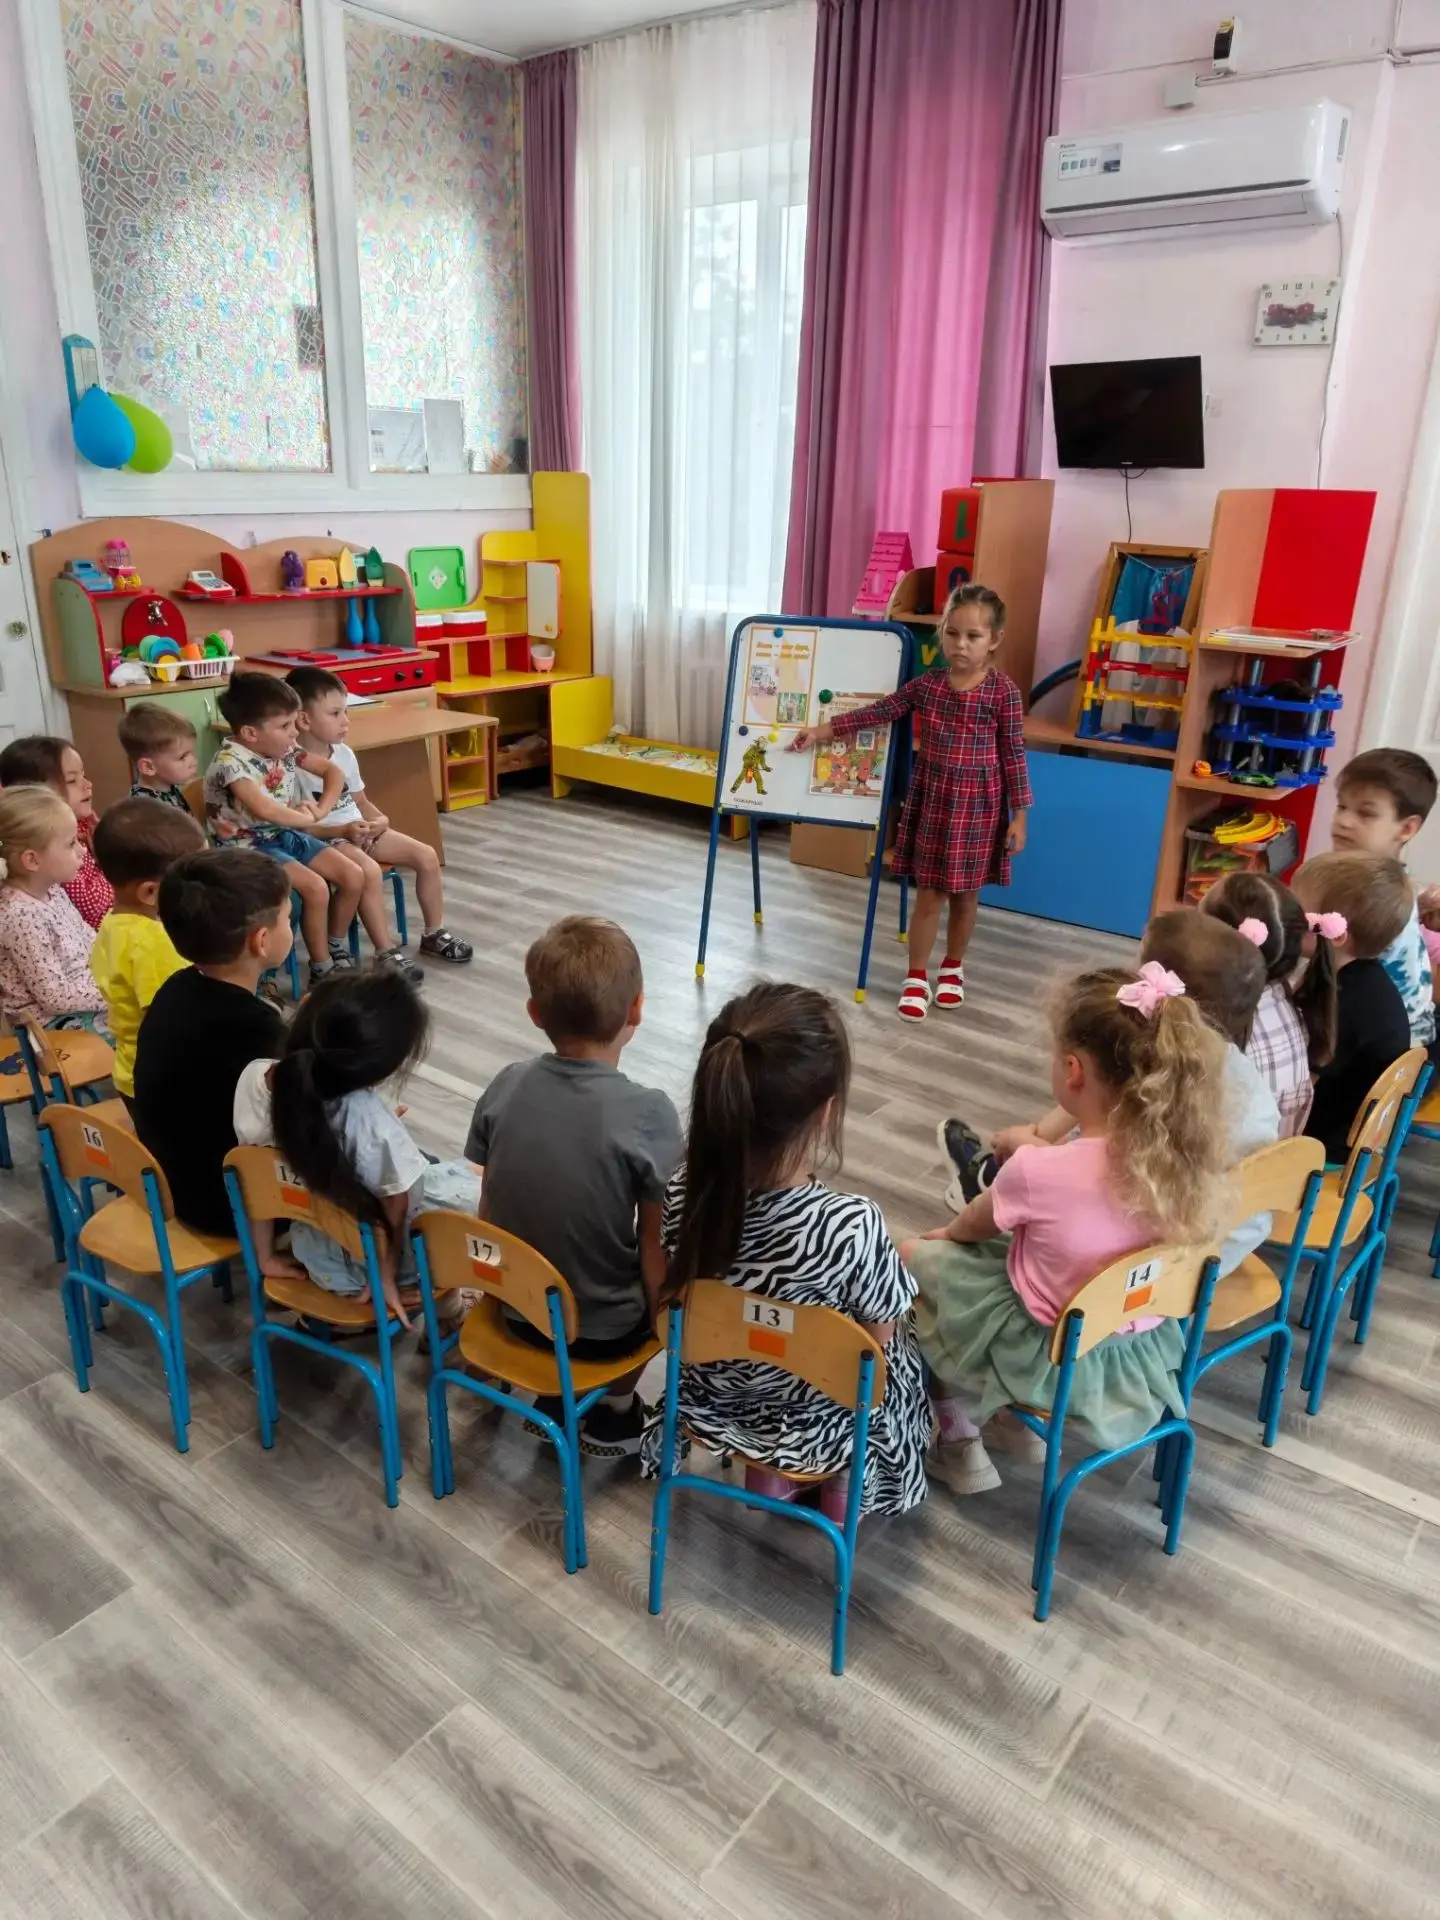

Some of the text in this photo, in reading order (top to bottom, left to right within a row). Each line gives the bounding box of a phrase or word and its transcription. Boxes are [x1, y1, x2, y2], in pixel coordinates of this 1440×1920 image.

[83, 1127, 102, 1147] 16
[472, 1239, 493, 1262] 17
[1129, 1263, 1152, 1288] 14
[751, 1304, 781, 1327] 13
